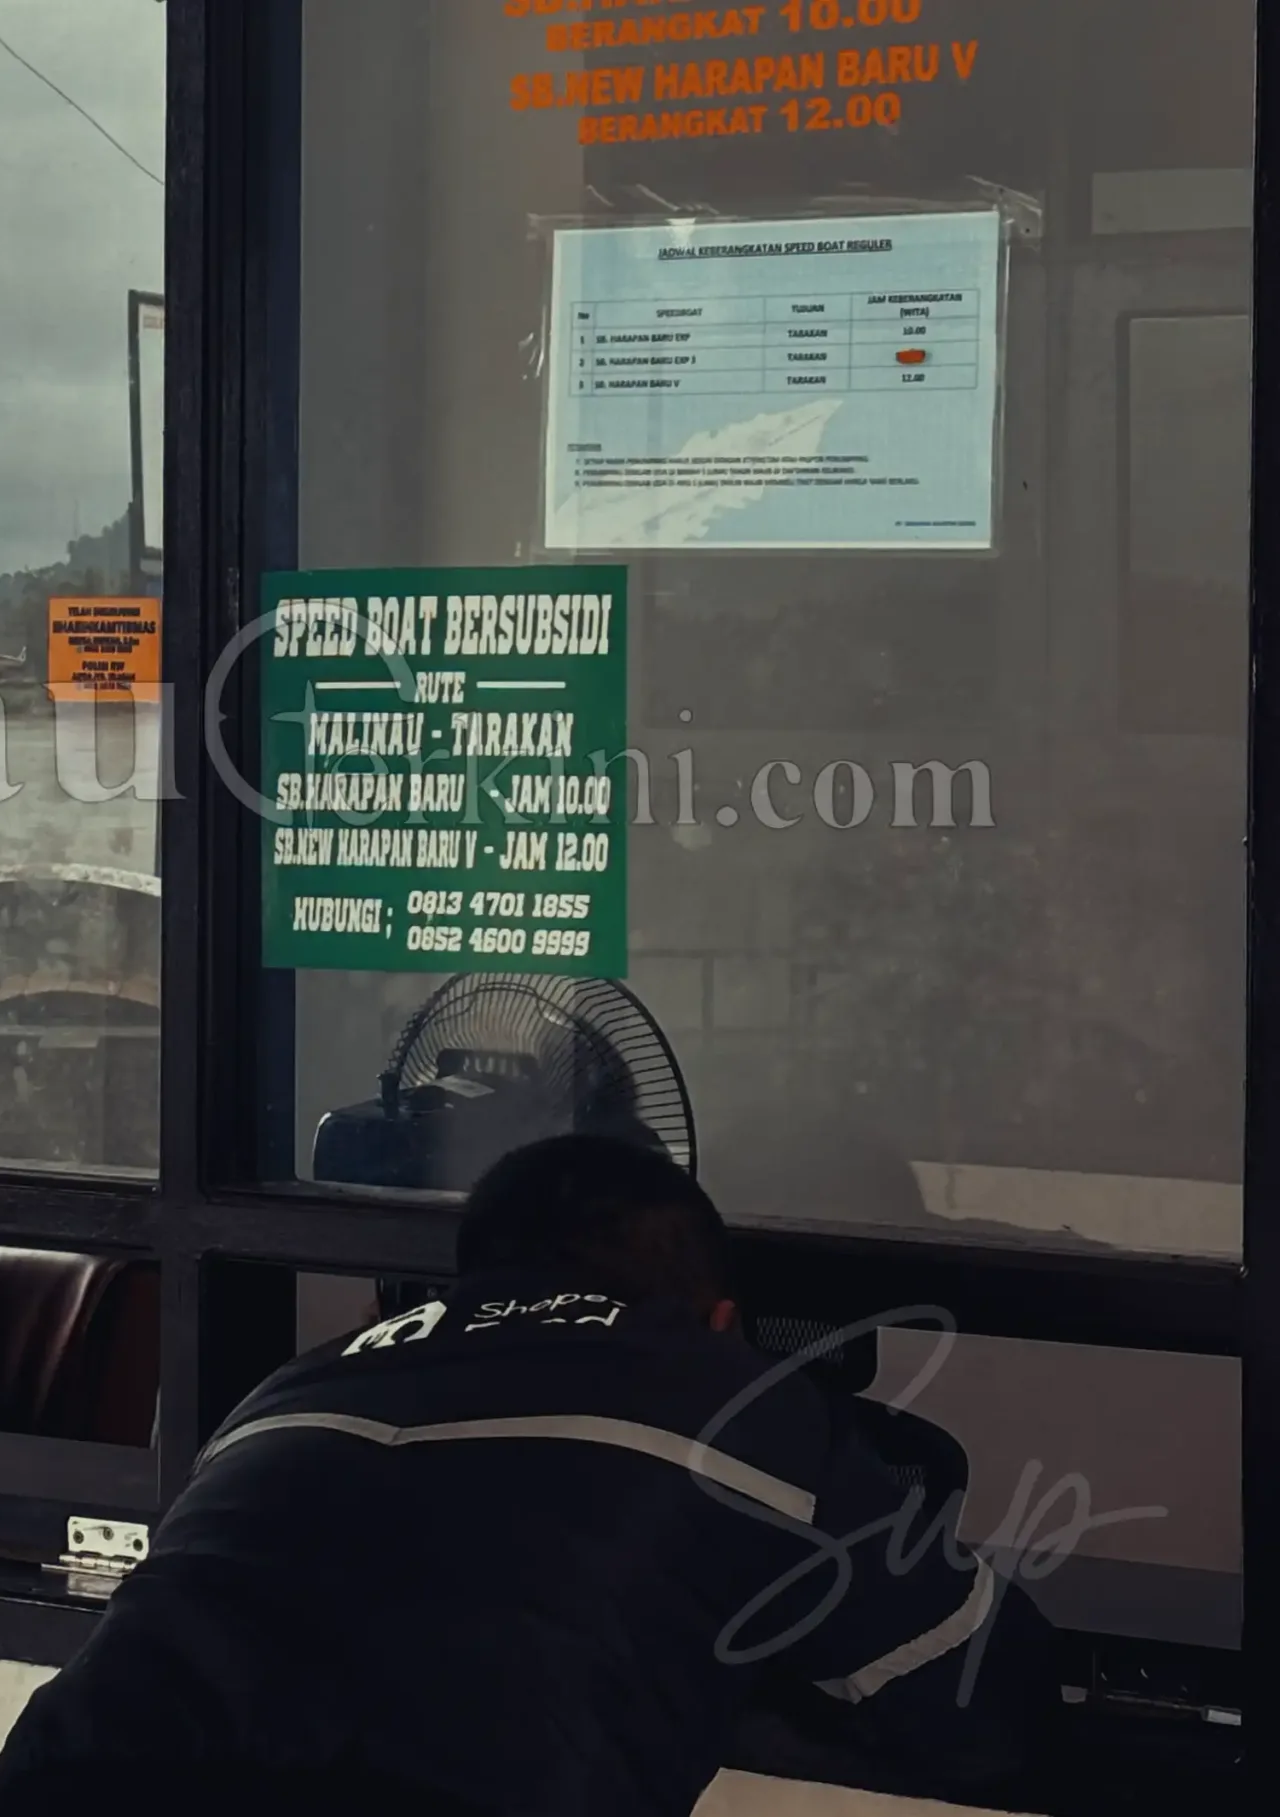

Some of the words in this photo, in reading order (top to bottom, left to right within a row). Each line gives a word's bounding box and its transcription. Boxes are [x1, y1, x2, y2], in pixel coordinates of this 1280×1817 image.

[545, 8, 764, 52] BERANGKAT
[780, 0, 921, 32] 10.00
[510, 67, 645, 111] SB.NEW
[654, 53, 825, 101] HARAPAN
[838, 44, 940, 87] BARU
[951, 40, 978, 79] V
[578, 105, 768, 146] BERANGKAT
[780, 92, 901, 133] 12.00
[659, 246, 696, 260] JADWAL
[783, 242, 815, 255] SPEED
[274, 597, 358, 657] SPEED
[364, 595, 438, 656] BOAT
[444, 593, 613, 656] BERSUBSIDI
[414, 671, 466, 704] RUTE
[308, 712, 424, 756] MALINAU
[451, 712, 575, 757] TARAKAN
[276, 773, 404, 812] SB.HARAPAN
[409, 773, 466, 812] BARU
[504, 775, 551, 814] JAM
[555, 776, 611, 815] 10.00
[274, 828, 334, 866] SB.NEW
[336, 828, 414, 867] HARAPAN
[416, 829, 463, 868] BARU
[465, 830, 477, 869] V
[499, 831, 548, 870] JAM
[555, 832, 609, 872] 12.00
[406, 890, 463, 915] 0813
[469, 892, 525, 917] 4701
[532, 894, 591, 919] 1855
[468, 928, 526, 954] 4600
[531, 930, 591, 957] 9999
